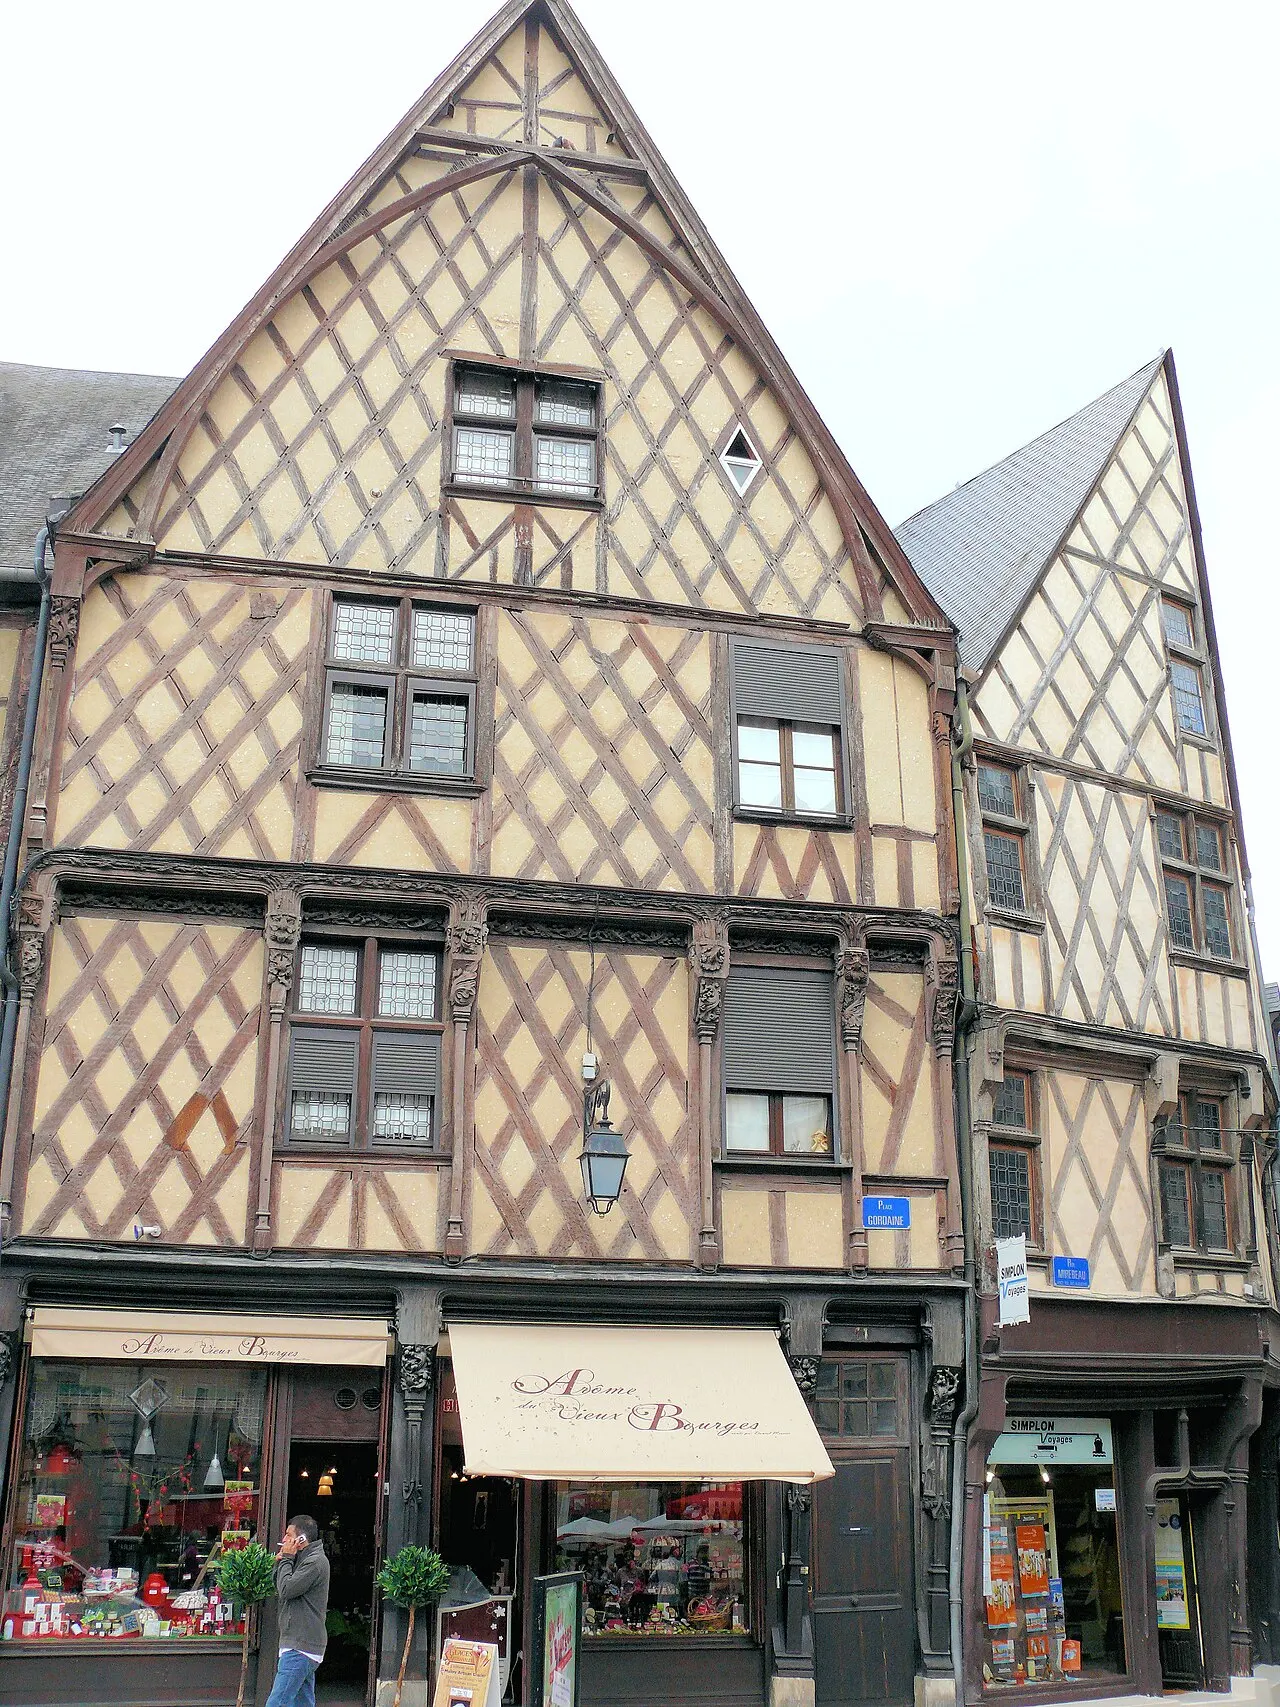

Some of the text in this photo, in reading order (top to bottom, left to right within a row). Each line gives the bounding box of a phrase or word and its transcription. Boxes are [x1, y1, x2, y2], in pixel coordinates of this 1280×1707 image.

[867, 1215, 904, 1226] GORDAINE
[1001, 1263, 1025, 1280] SIMPLON
[1057, 1269, 1087, 1281] MIREBEAU
[1003, 1282, 1026, 1299] Voyages
[121, 1334, 181, 1354] Arôme
[194, 1337, 233, 1354] Vieux
[238, 1335, 298, 1361] Bourges
[511, 1368, 637, 1396] Arôme
[541, 1396, 623, 1421] Vieux
[627, 1403, 760, 1437] Bourges
[1010, 1420, 1055, 1432] SIMPLON
[1041, 1433, 1073, 1445] Voyages
